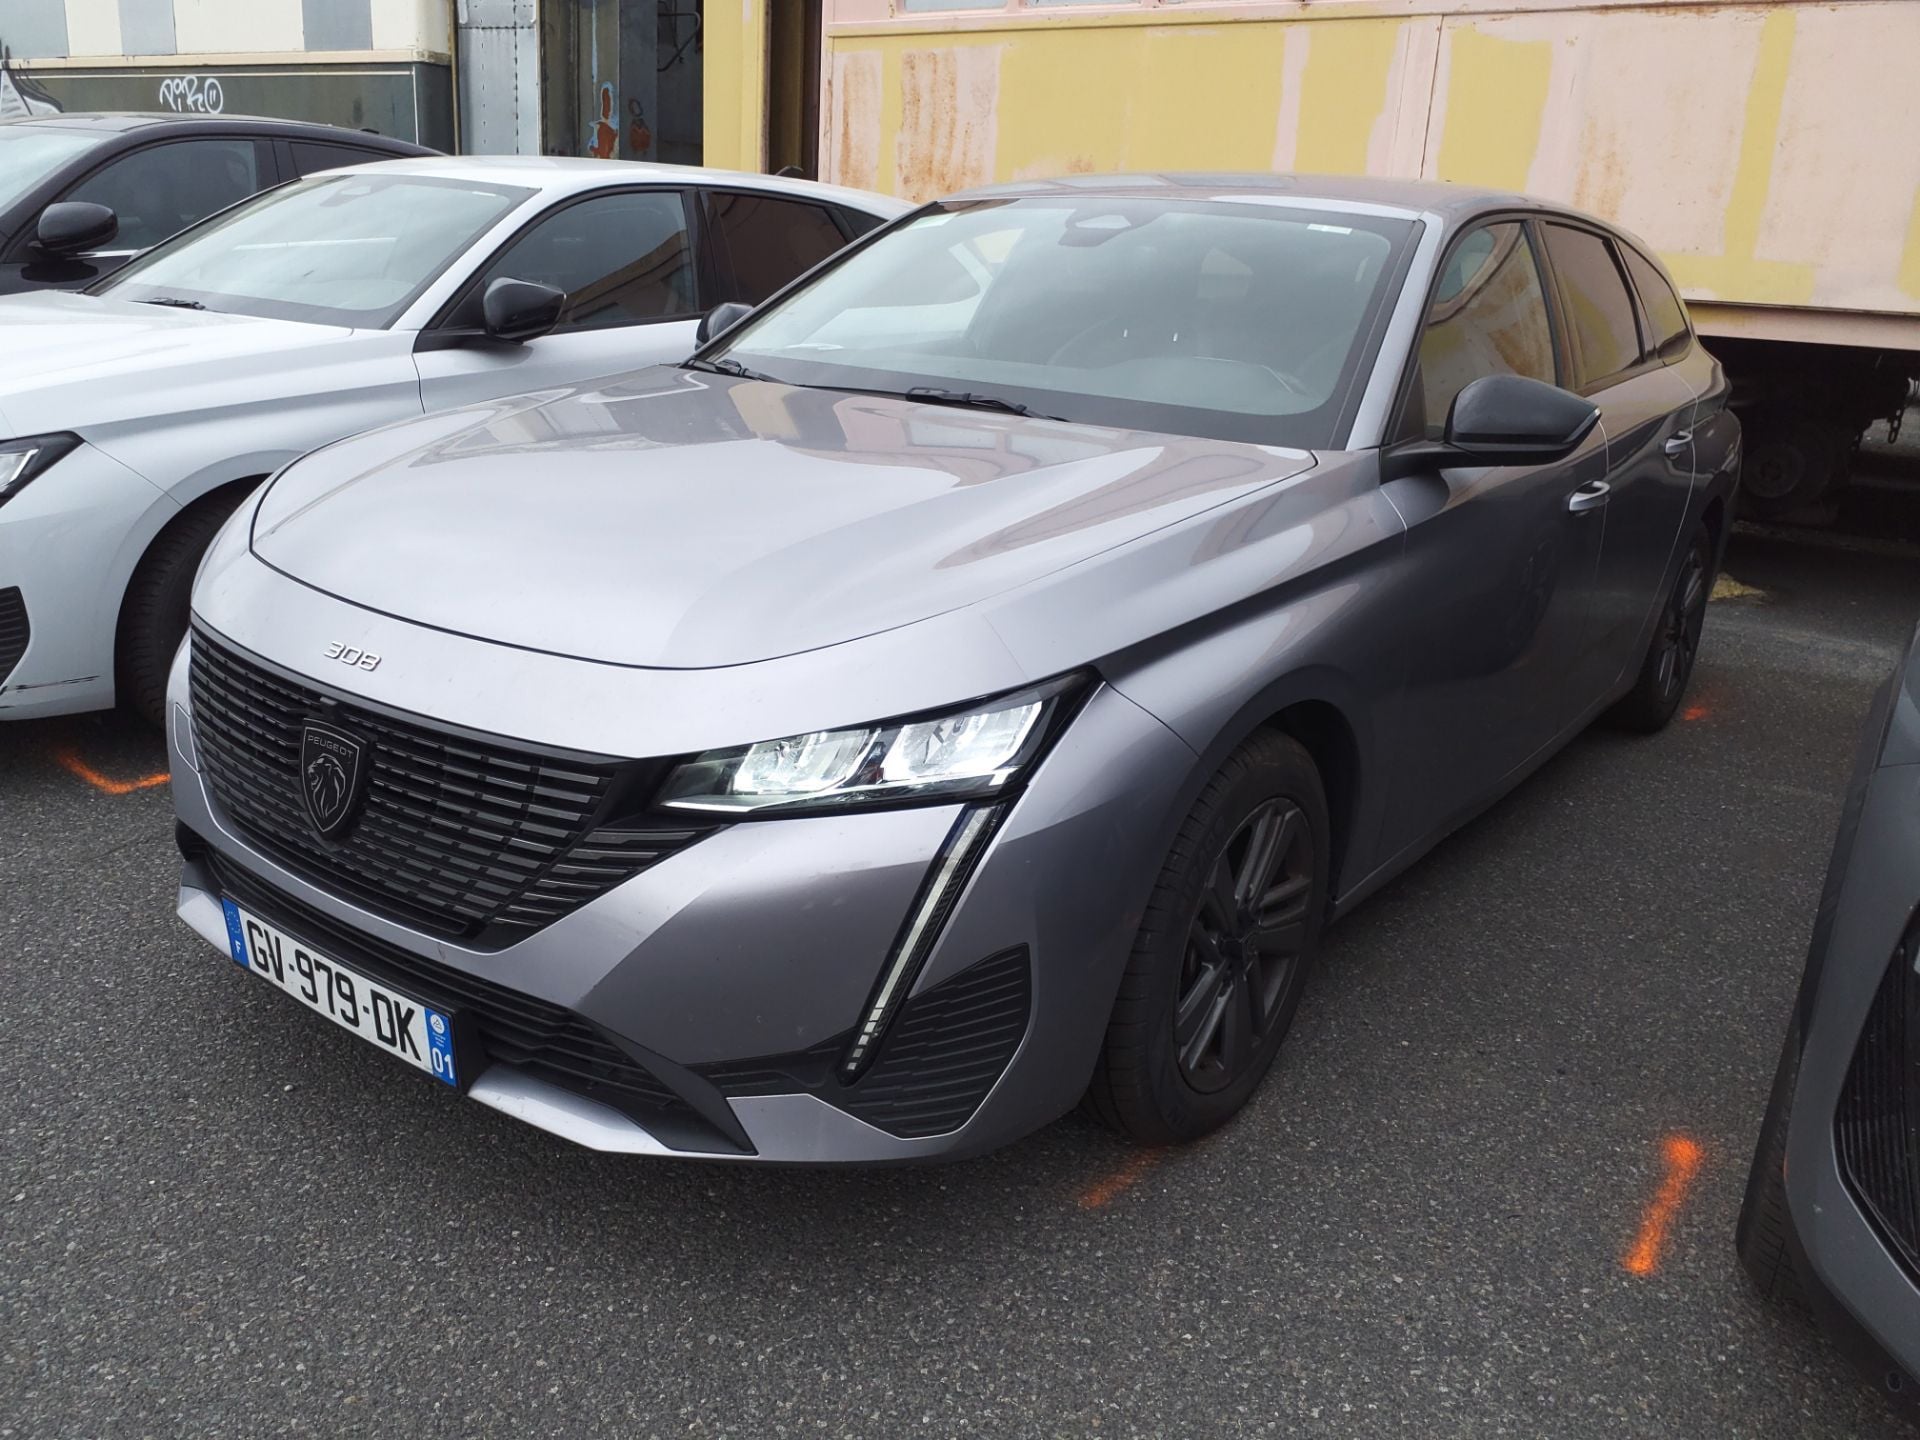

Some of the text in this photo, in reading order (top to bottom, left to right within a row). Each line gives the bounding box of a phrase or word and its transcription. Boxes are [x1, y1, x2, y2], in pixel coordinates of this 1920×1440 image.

[323, 640, 382, 672] 308
[307, 734, 354, 758] PEUGEOT
[235, 940, 241, 953] F
[247, 920, 422, 1062] GV-979-DK
[432, 1047, 454, 1079] 01
